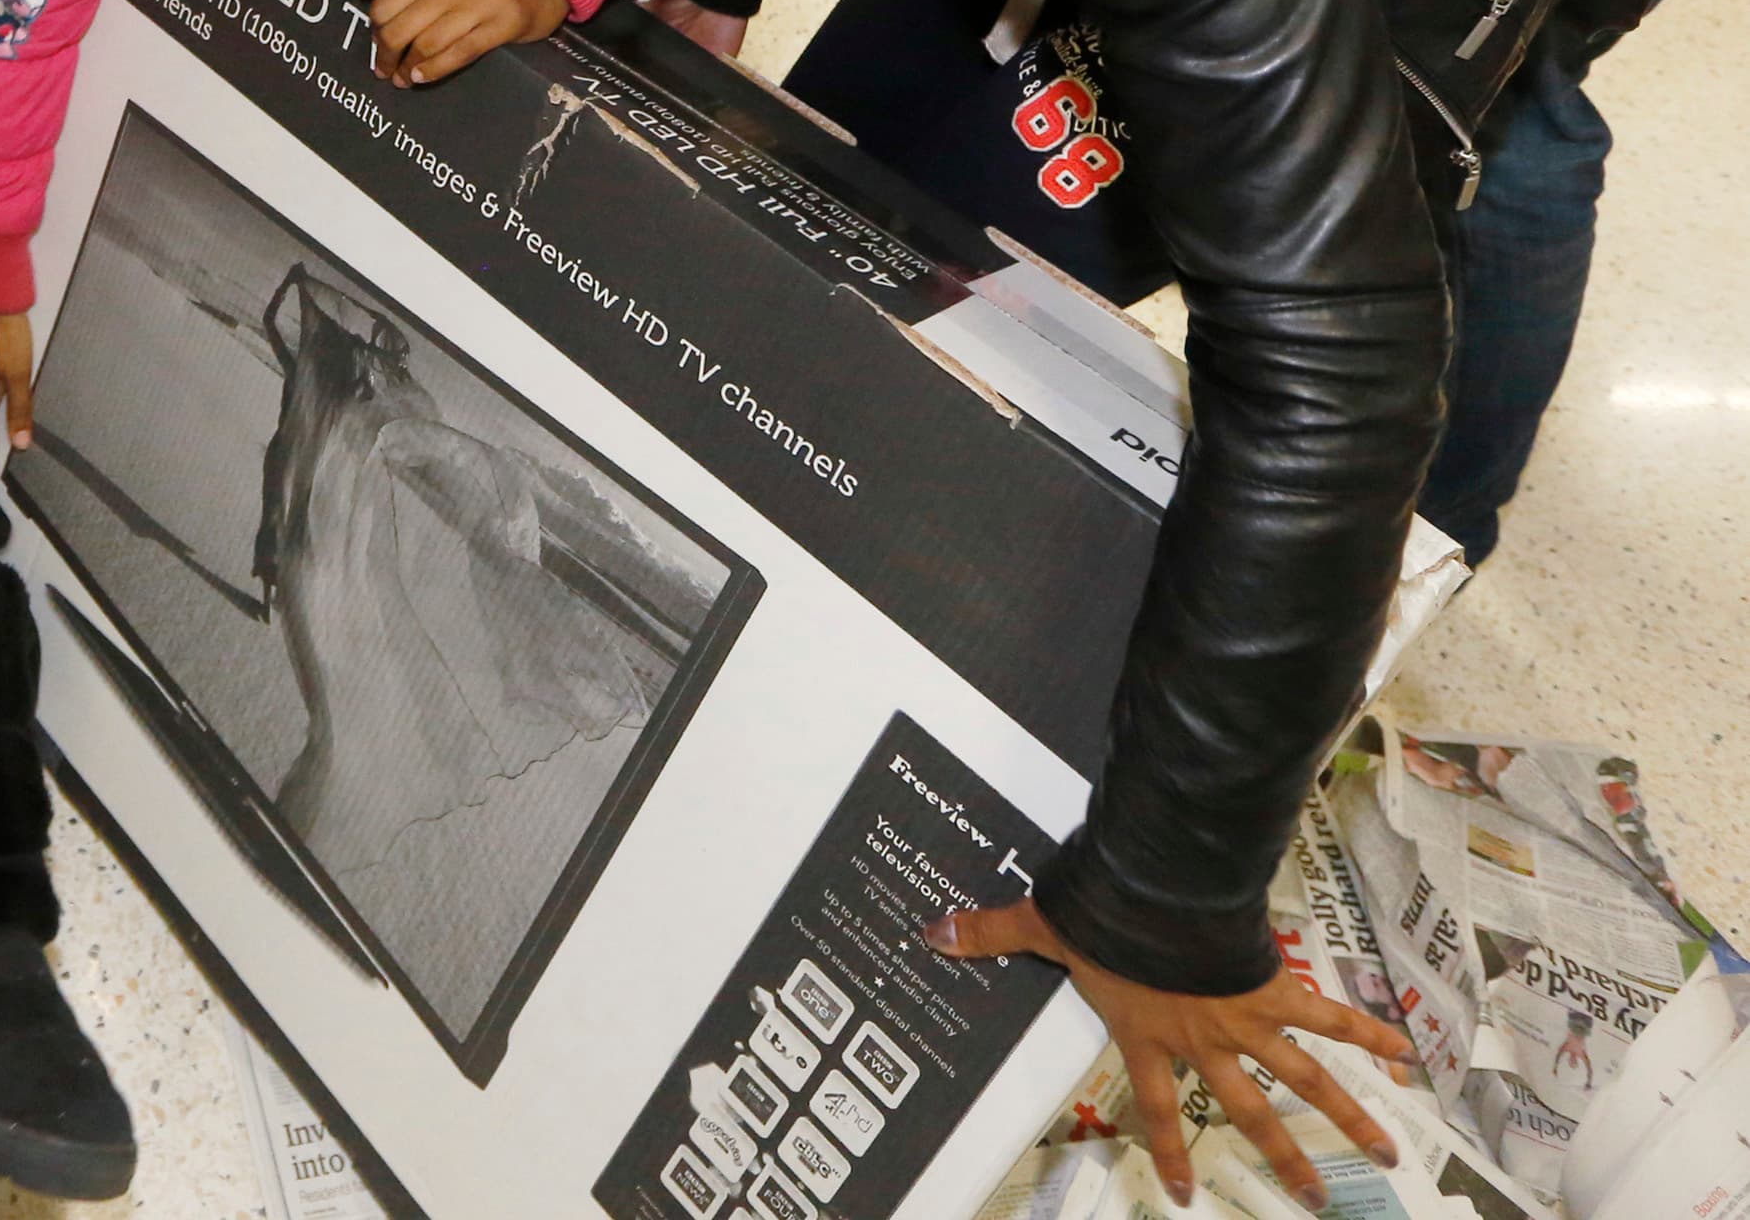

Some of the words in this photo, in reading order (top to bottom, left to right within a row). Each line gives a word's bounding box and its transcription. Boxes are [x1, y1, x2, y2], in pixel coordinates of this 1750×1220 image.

[572, 73, 623, 107] TV
[586, 65, 649, 104] quality
[1023, 78, 1042, 98] &
[628, 108, 697, 154] LED
[645, 100, 713, 144] (1080p)
[1011, 75, 1125, 210] 68
[695, 153, 756, 195] HD
[712, 142, 741, 164] HD
[735, 159, 778, 189] Full
[758, 194, 828, 243] Full
[780, 187, 862, 242] glorious
[830, 204, 890, 245] family
[241, 8, 317, 80] (1080p)
[317, 71, 392, 138] quality
[394, 123, 478, 205] images
[480, 192, 501, 220] &
[503, 207, 621, 311] Freeview
[621, 298, 669, 347] HD
[678, 338, 723, 386] TV
[719, 380, 860, 500] channels
[862, 239, 919, 282] Enjoy
[889, 239, 931, 274] with
[1109, 427, 1180, 478] oid
[888, 754, 994, 850] Freeview
[850, 855, 870, 876] HD
[865, 832, 943, 907] television
[875, 814, 913, 853] Your
[914, 851, 980, 912] favourit
[1293, 833, 1327, 883] goo
[862, 884, 881, 902] TV
[878, 900, 909, 932] series
[1309, 884, 1352, 953] Jolly
[1317, 839, 1382, 958] Richard
[821, 906, 842, 929] and
[842, 925, 894, 977] enhanced
[893, 974, 924, 1006] audio
[924, 1001, 958, 1038] clarity
[823, 888, 840, 909] Up
[841, 903, 853, 920] to
[853, 916, 862, 929] 5
[862, 923, 892, 957] times
[891, 952, 933, 994] sharper
[931, 992, 971, 1031] picture
[790, 915, 817, 942] Over
[816, 938, 832, 957] 50
[831, 954, 877, 1001] standard
[874, 996, 912, 1034] digital
[909, 1030, 957, 1080] channels
[800, 988, 830, 1021] one
[862, 1050, 895, 1086] TWO
[291, 1153, 346, 1181] into
